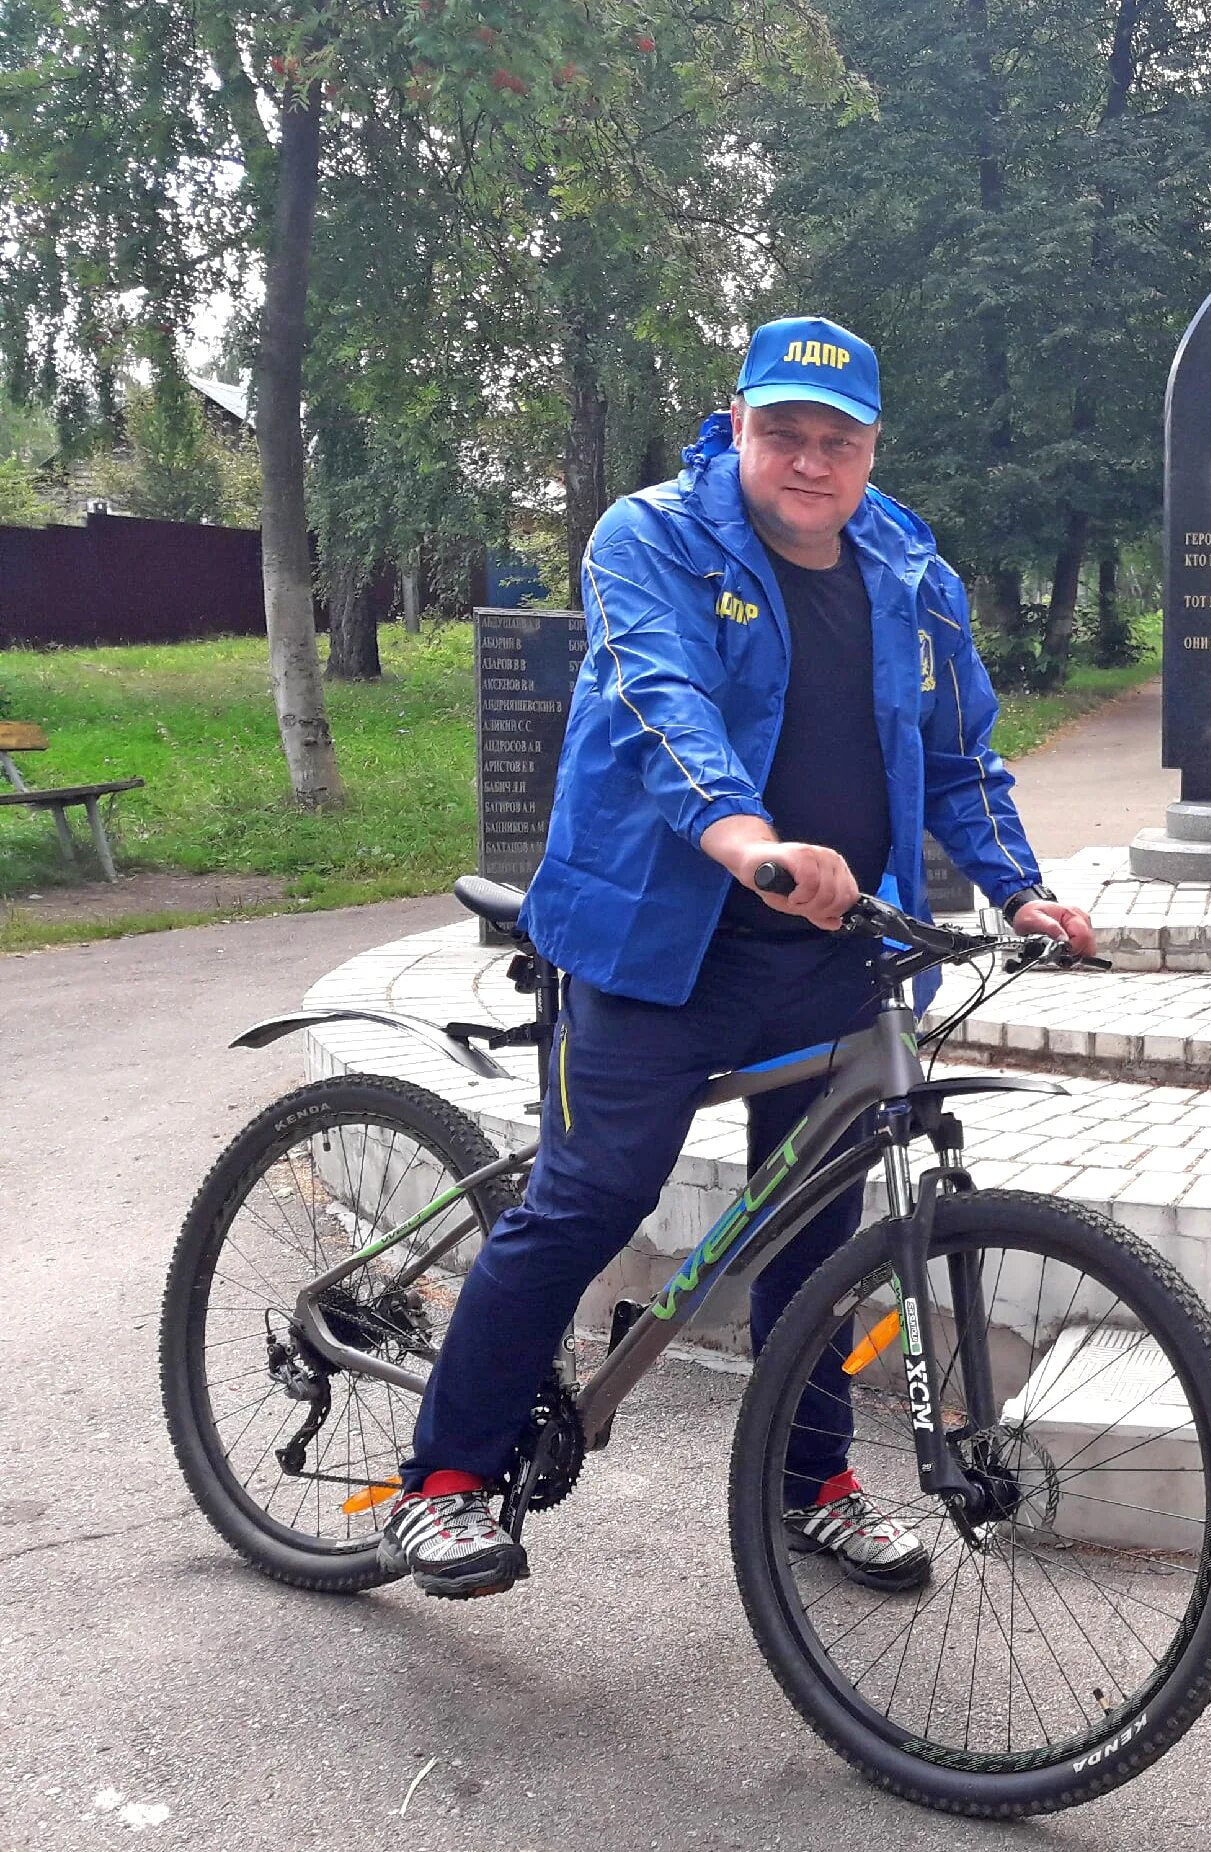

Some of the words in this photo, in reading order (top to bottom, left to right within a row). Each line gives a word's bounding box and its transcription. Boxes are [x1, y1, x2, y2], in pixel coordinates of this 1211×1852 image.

[784, 340, 850, 369] ЛДПР
[1185, 554, 1206, 567] КТО
[1184, 596, 1206, 608] ТОТ
[1184, 637, 1209, 650] ОНИ
[274, 1102, 331, 1131] KENDA
[905, 1359, 934, 1432] XCM
[1072, 1713, 1147, 1774] KENDA
